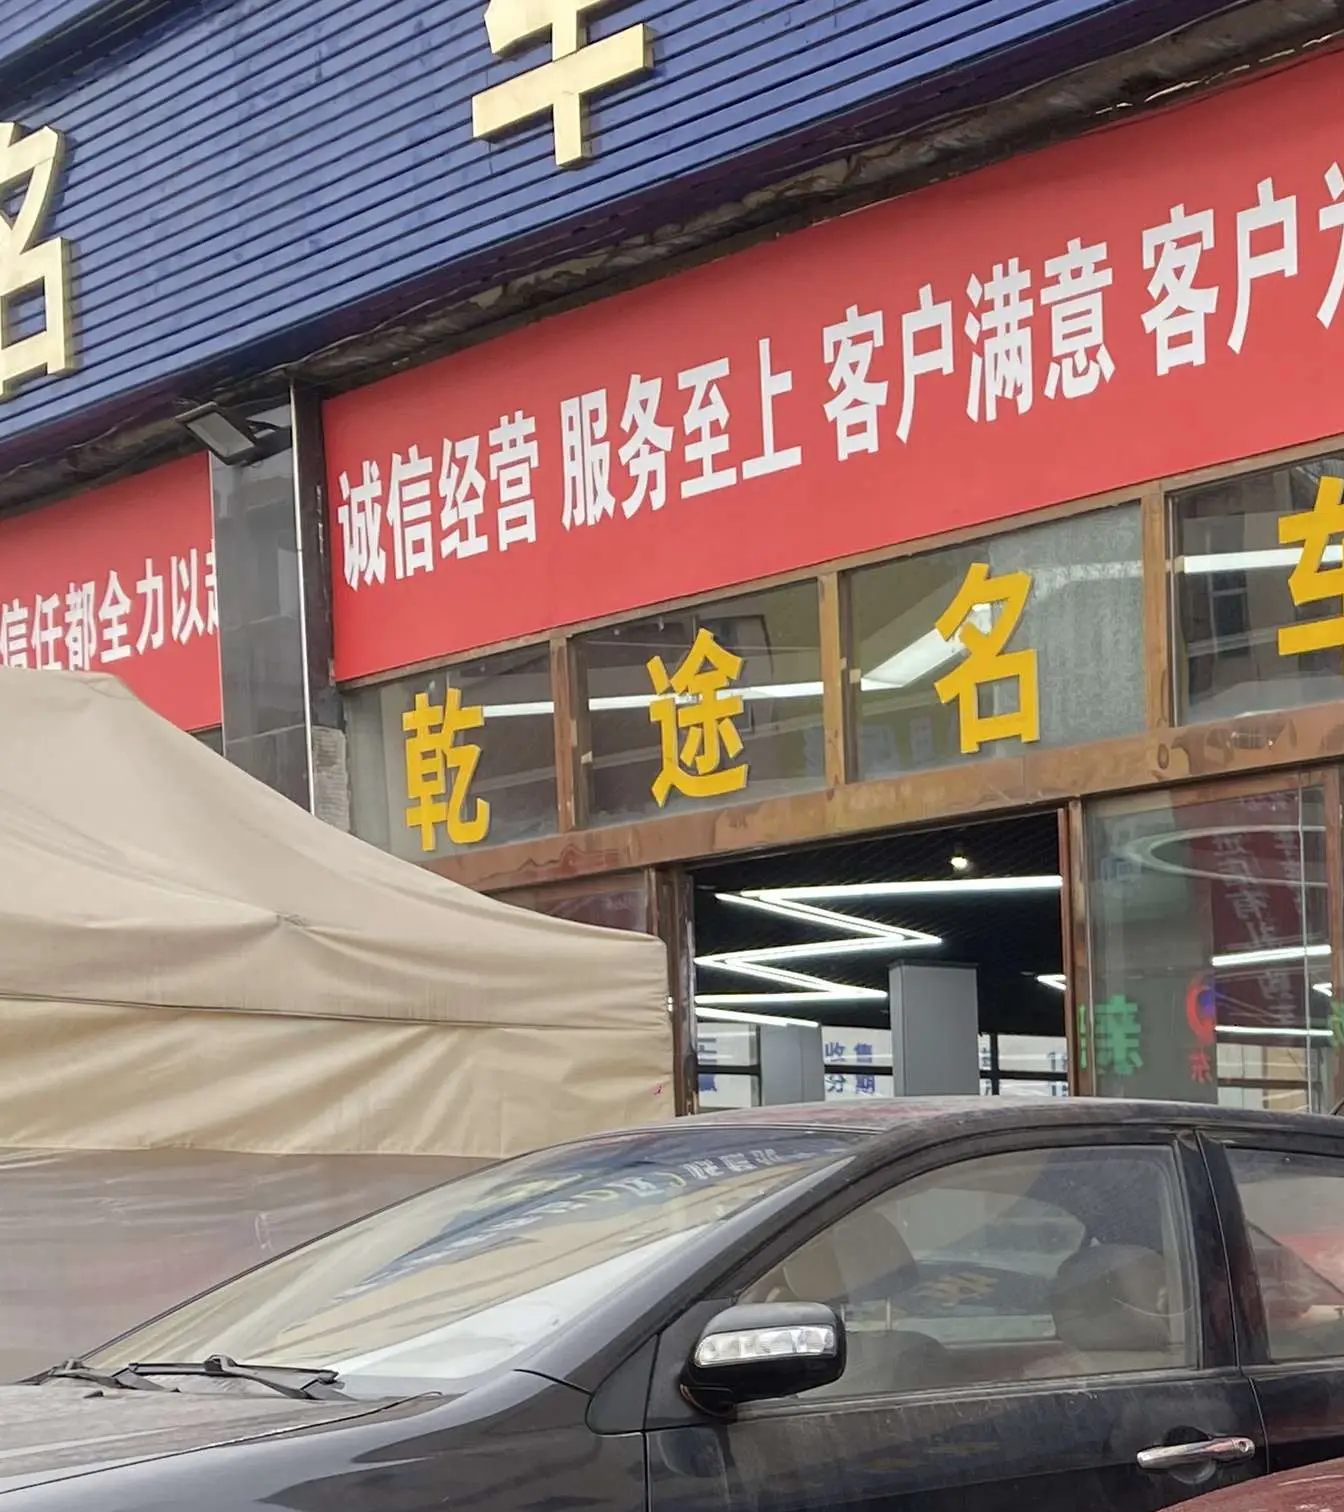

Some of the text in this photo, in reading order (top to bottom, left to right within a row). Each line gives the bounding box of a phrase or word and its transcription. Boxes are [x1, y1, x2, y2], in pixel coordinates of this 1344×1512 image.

[337, 410, 539, 587] 诚信经营
[560, 337, 802, 531] 服务至上
[821, 237, 1116, 462] 客户满意
